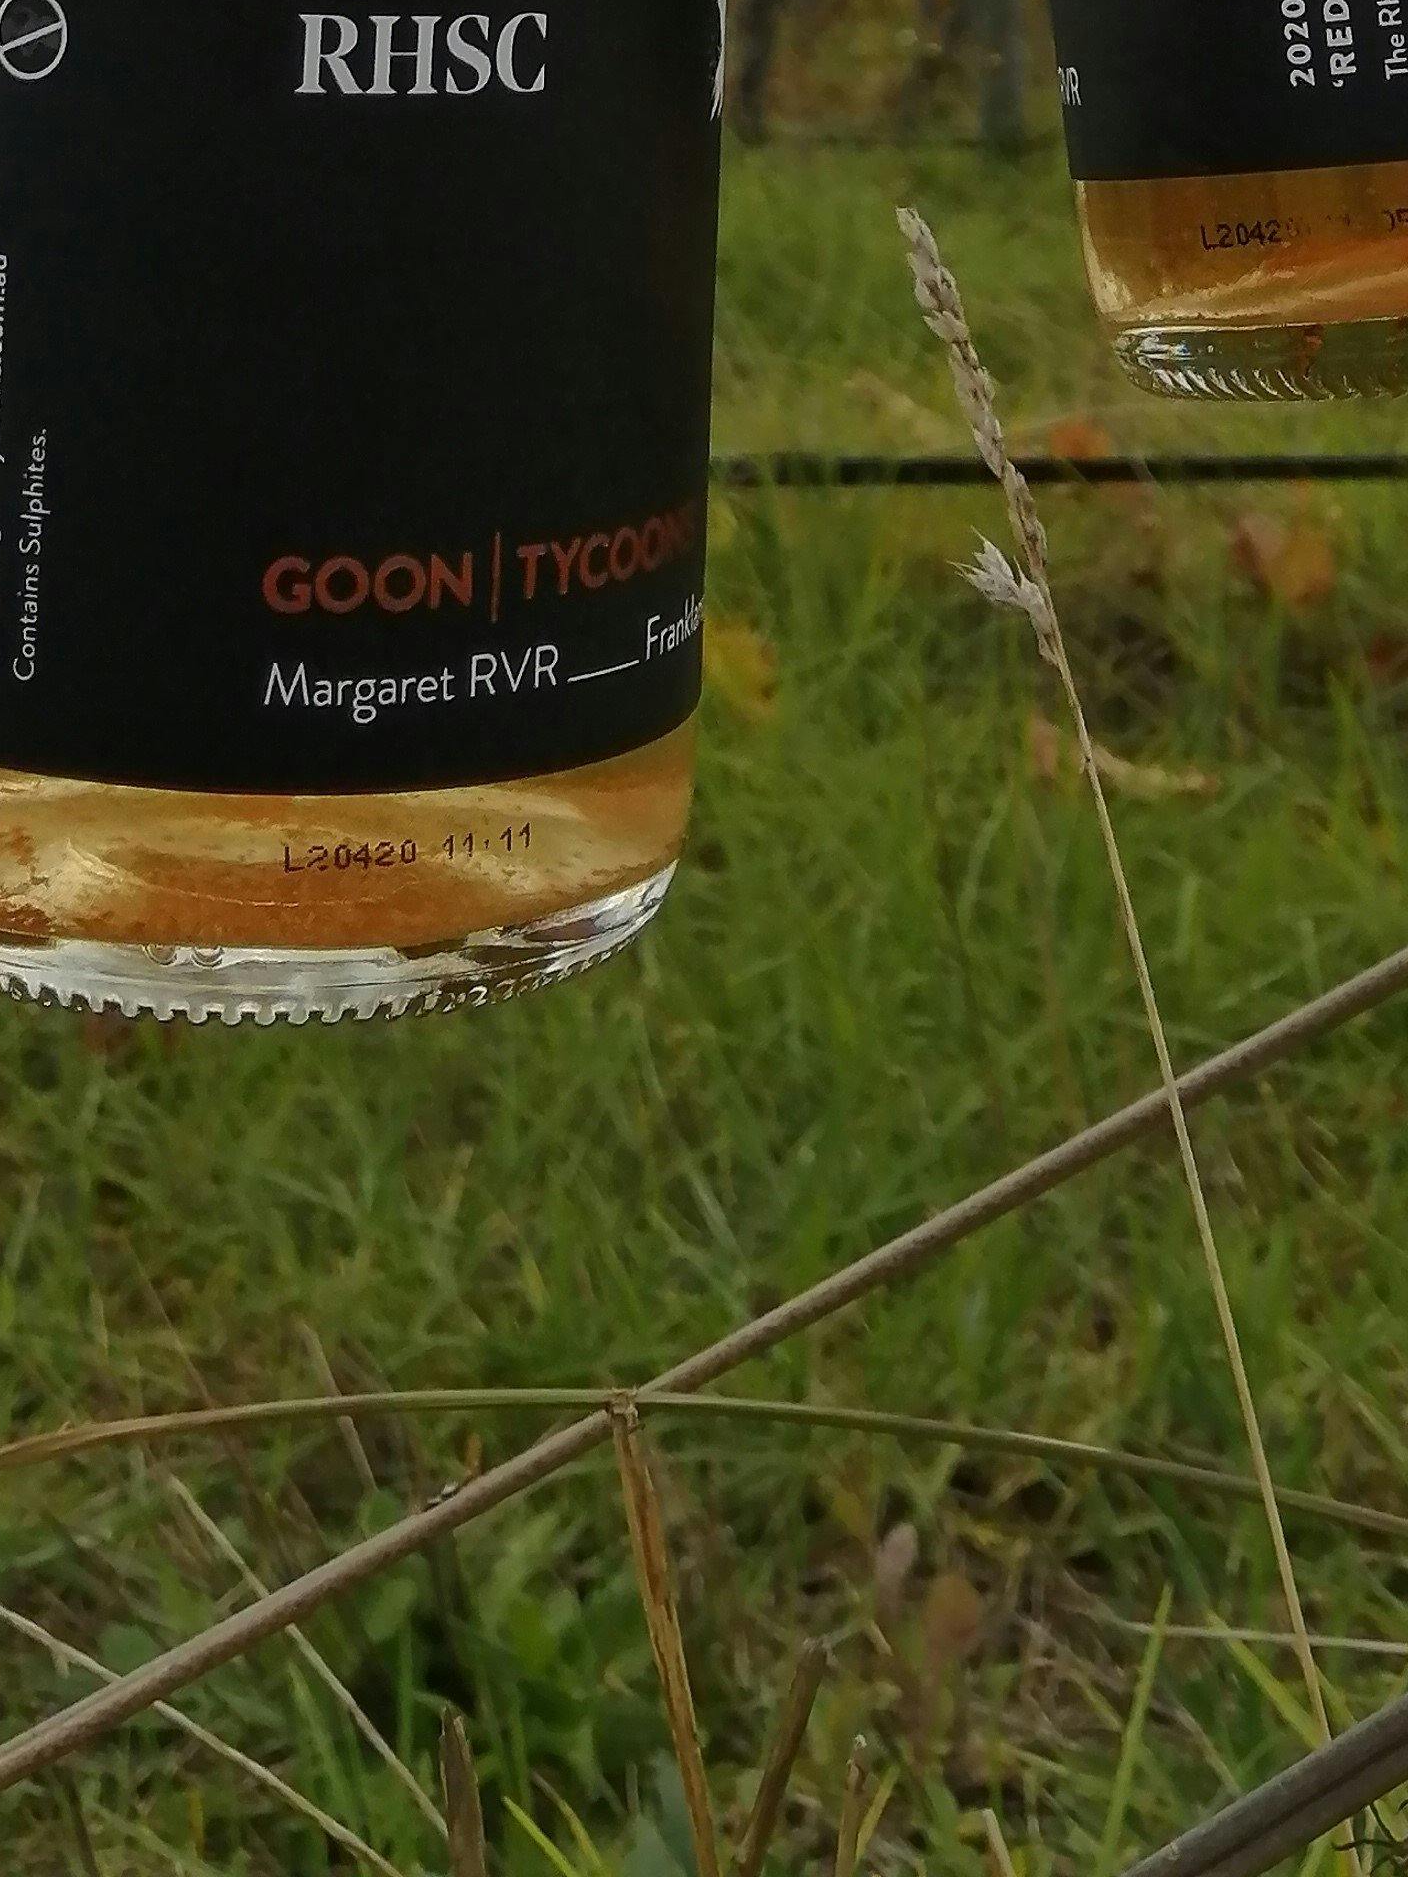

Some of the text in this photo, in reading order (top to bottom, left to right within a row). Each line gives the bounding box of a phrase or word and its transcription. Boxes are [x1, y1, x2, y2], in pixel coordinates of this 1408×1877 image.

[294, 12, 548, 96] RHSC
[12, 428, 52, 681] Contains Sulphites.
[262, 552, 473, 615] GOON
[264, 661, 455, 724] Margaret
[470, 644, 558, 699] RVR
[283, 838, 417, 874] L20420
